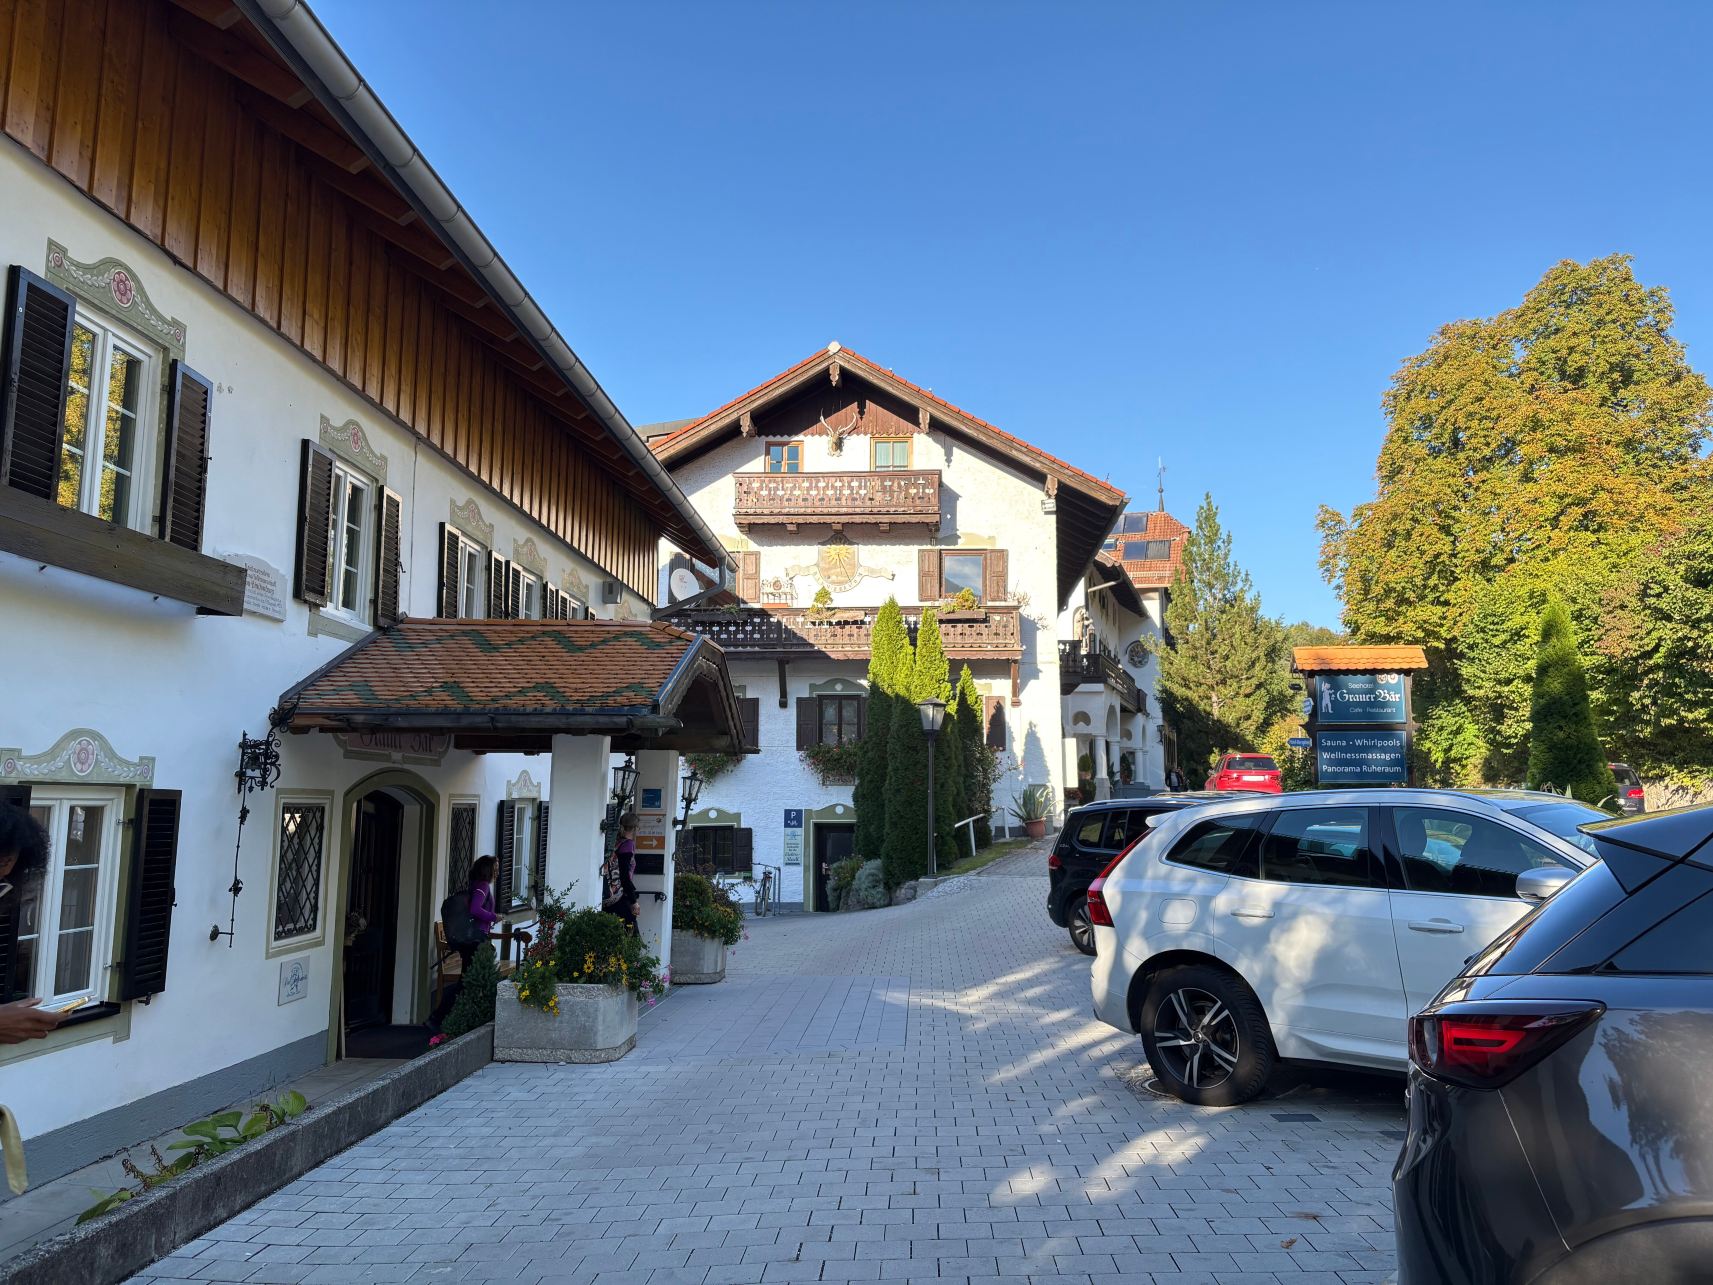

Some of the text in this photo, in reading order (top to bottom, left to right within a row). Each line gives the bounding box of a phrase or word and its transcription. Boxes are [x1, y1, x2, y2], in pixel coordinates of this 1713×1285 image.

[1337, 689, 1401, 702] Grauer Bär
[1321, 738, 1401, 748] Sauna Whirlpools
[1322, 751, 1401, 760] Wellnessmassagen
[1322, 765, 1402, 773] Panorama Ruheraum
